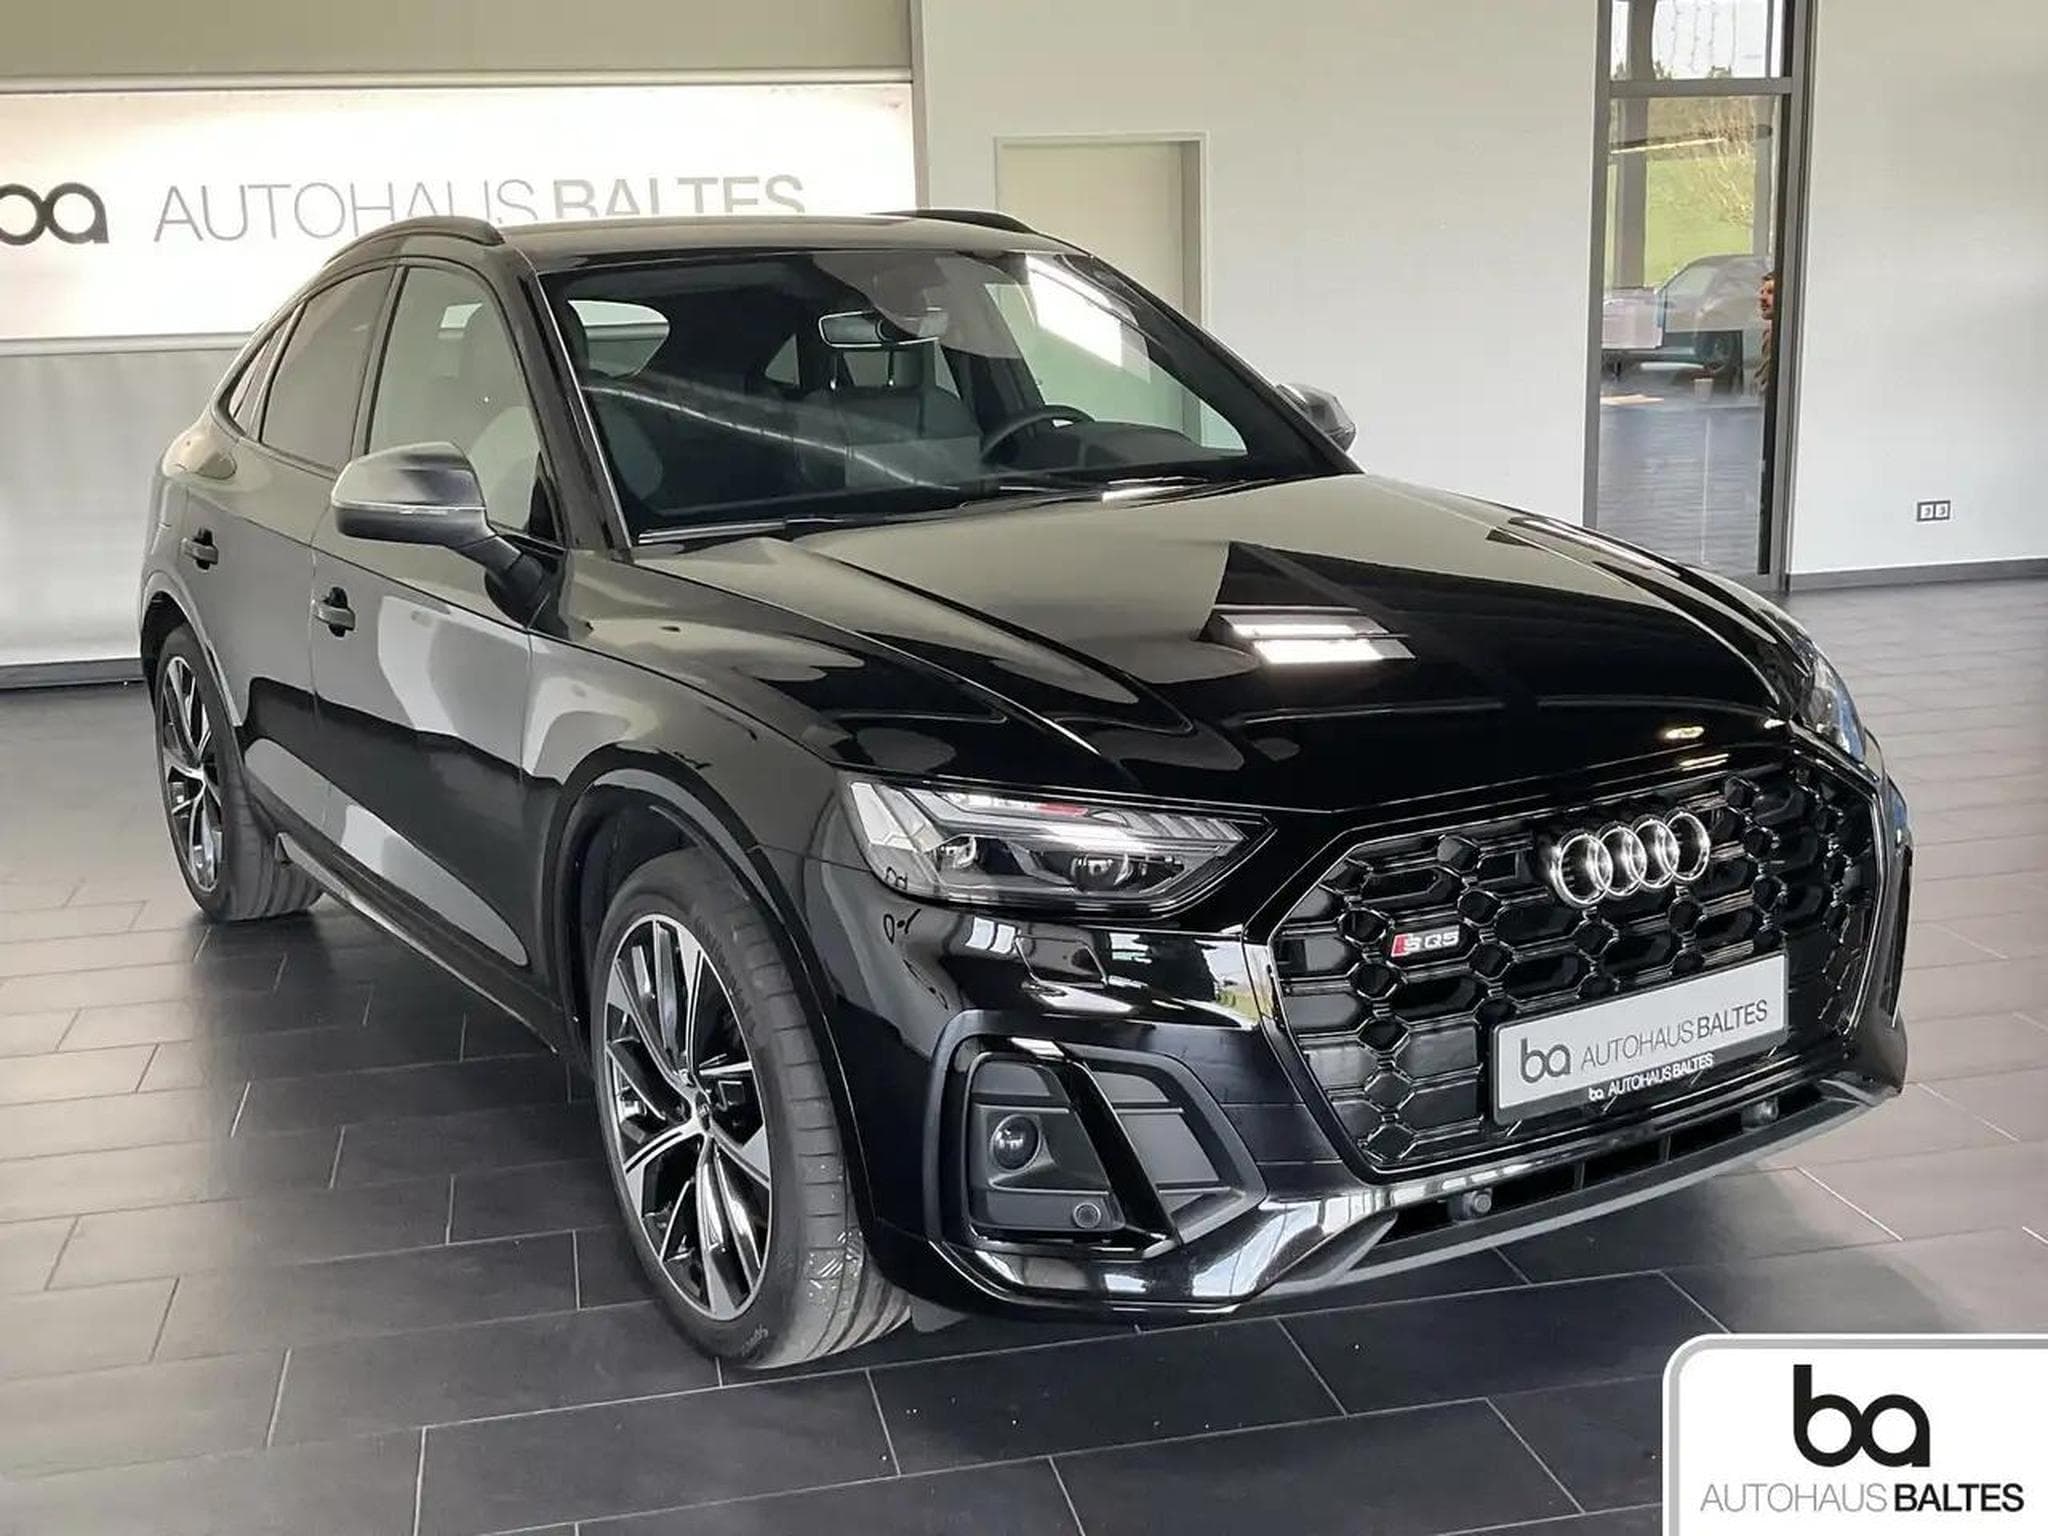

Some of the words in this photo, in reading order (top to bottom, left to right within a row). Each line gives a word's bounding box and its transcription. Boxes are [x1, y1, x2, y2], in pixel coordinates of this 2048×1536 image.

[1520, 1037, 1571, 1084] ba
[1580, 1020, 1694, 1071] AUTOHAUS
[1696, 999, 1768, 1039] BALTES
[1607, 1065, 1672, 1097] AUTOHAUS
[1672, 1052, 1715, 1081] BALTES
